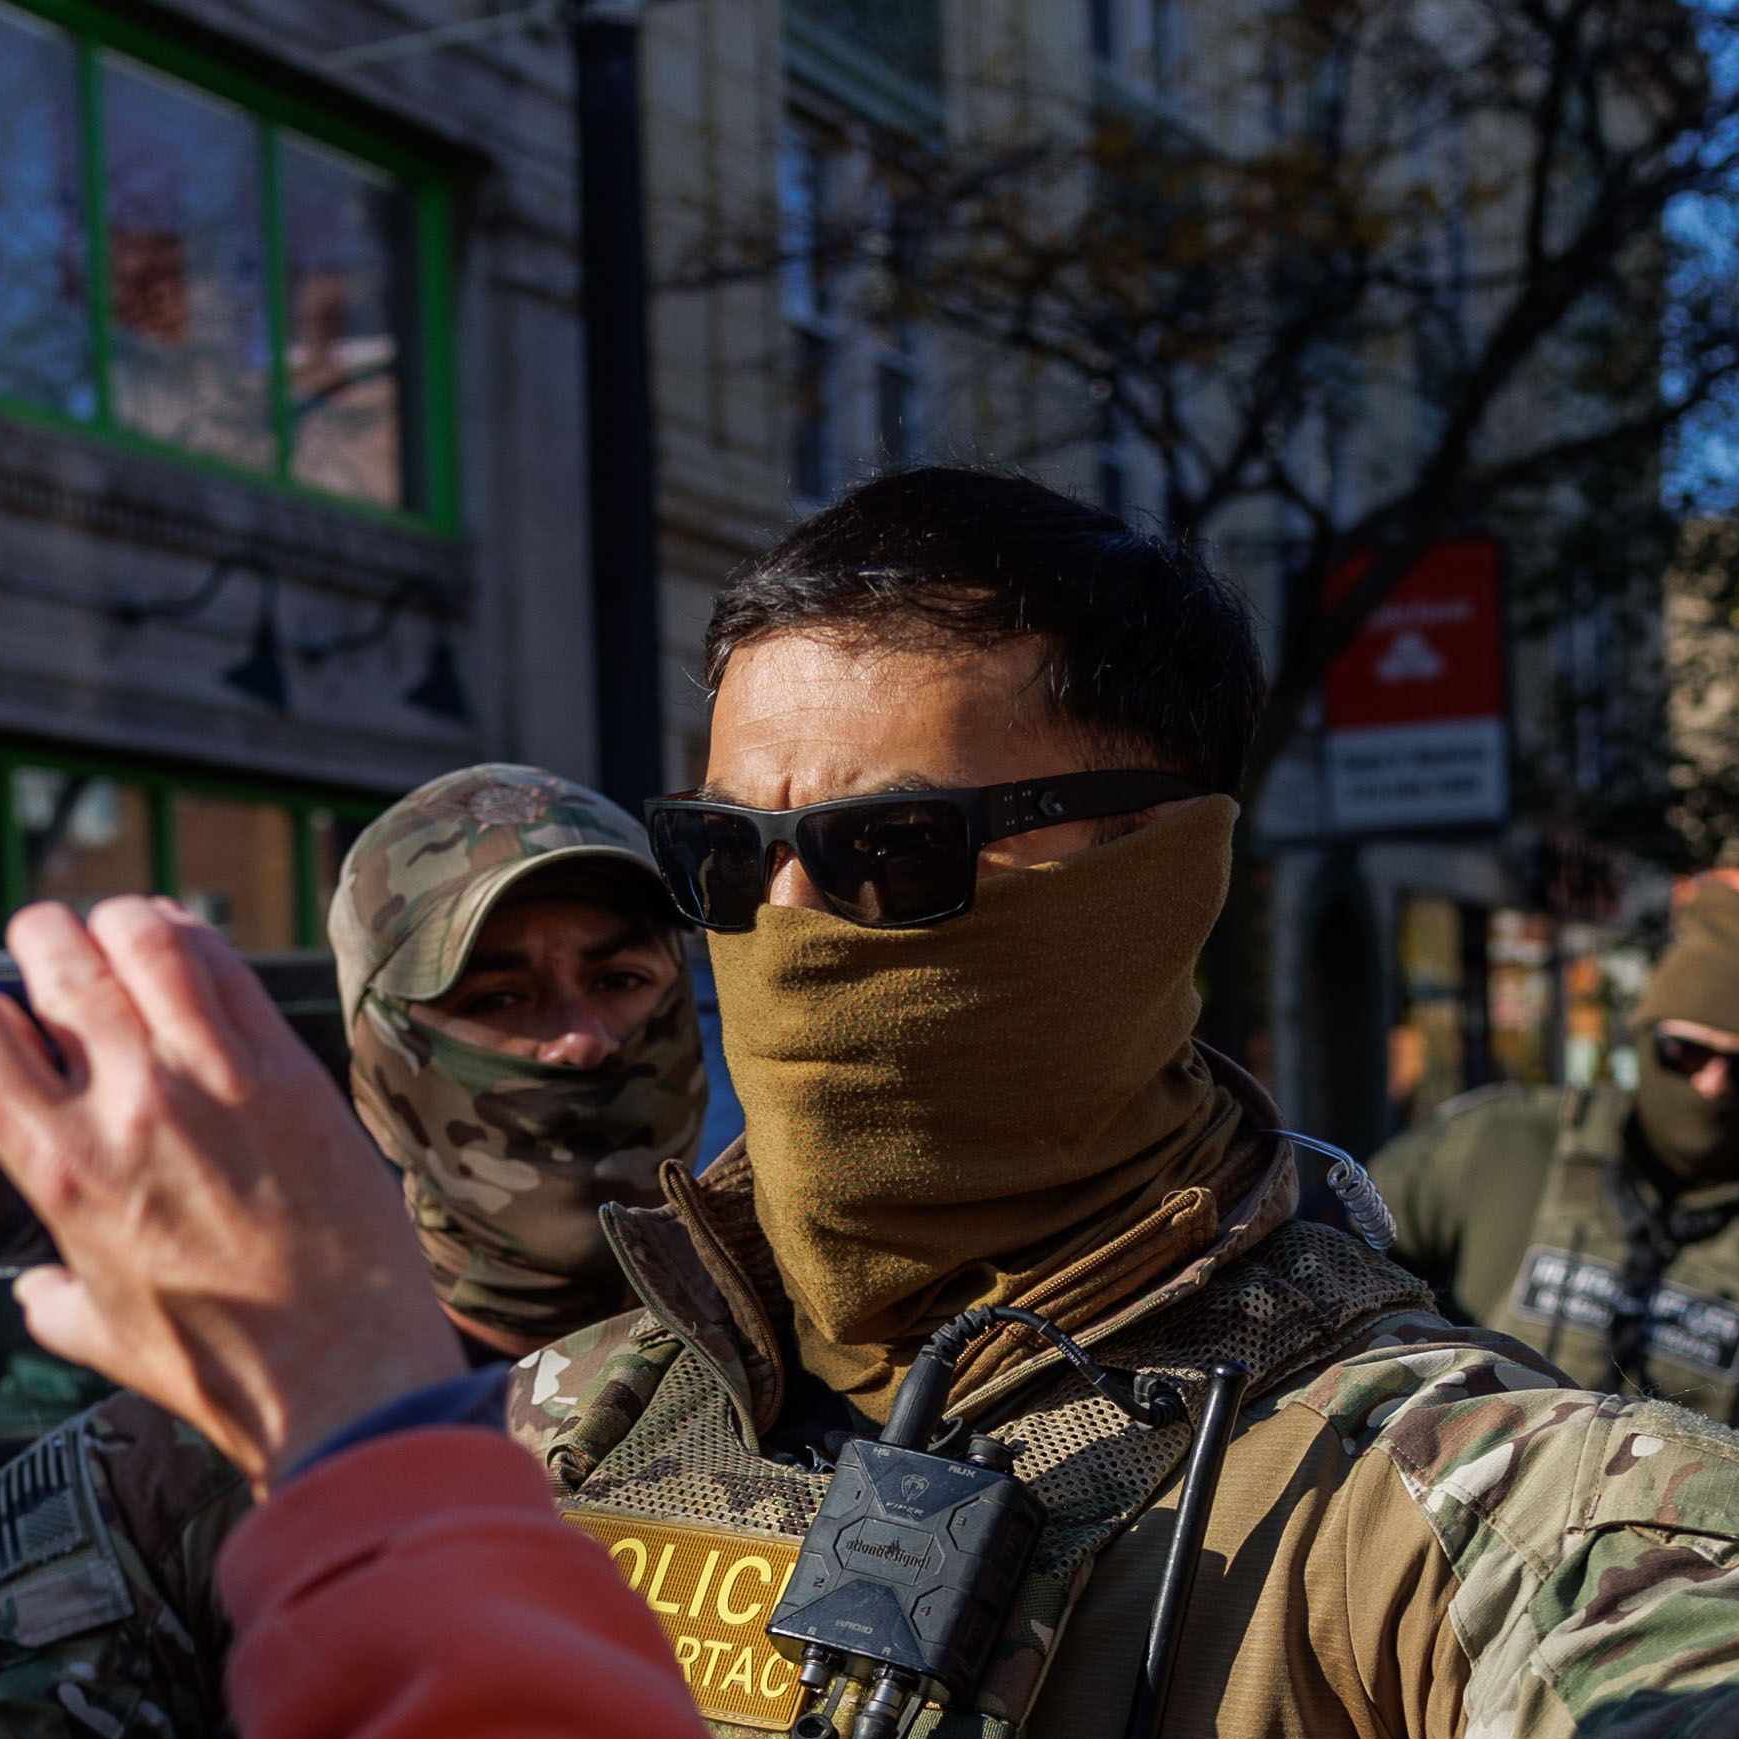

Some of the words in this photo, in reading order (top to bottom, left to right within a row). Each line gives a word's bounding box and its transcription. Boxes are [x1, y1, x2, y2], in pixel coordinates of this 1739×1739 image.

[947, 1464, 977, 1479] AUX
[885, 1501, 925, 1517] VIPER
[608, 1537, 799, 1626] OLIC
[834, 1618, 874, 1635] RADIO
[675, 1635, 795, 1698] RTAC
